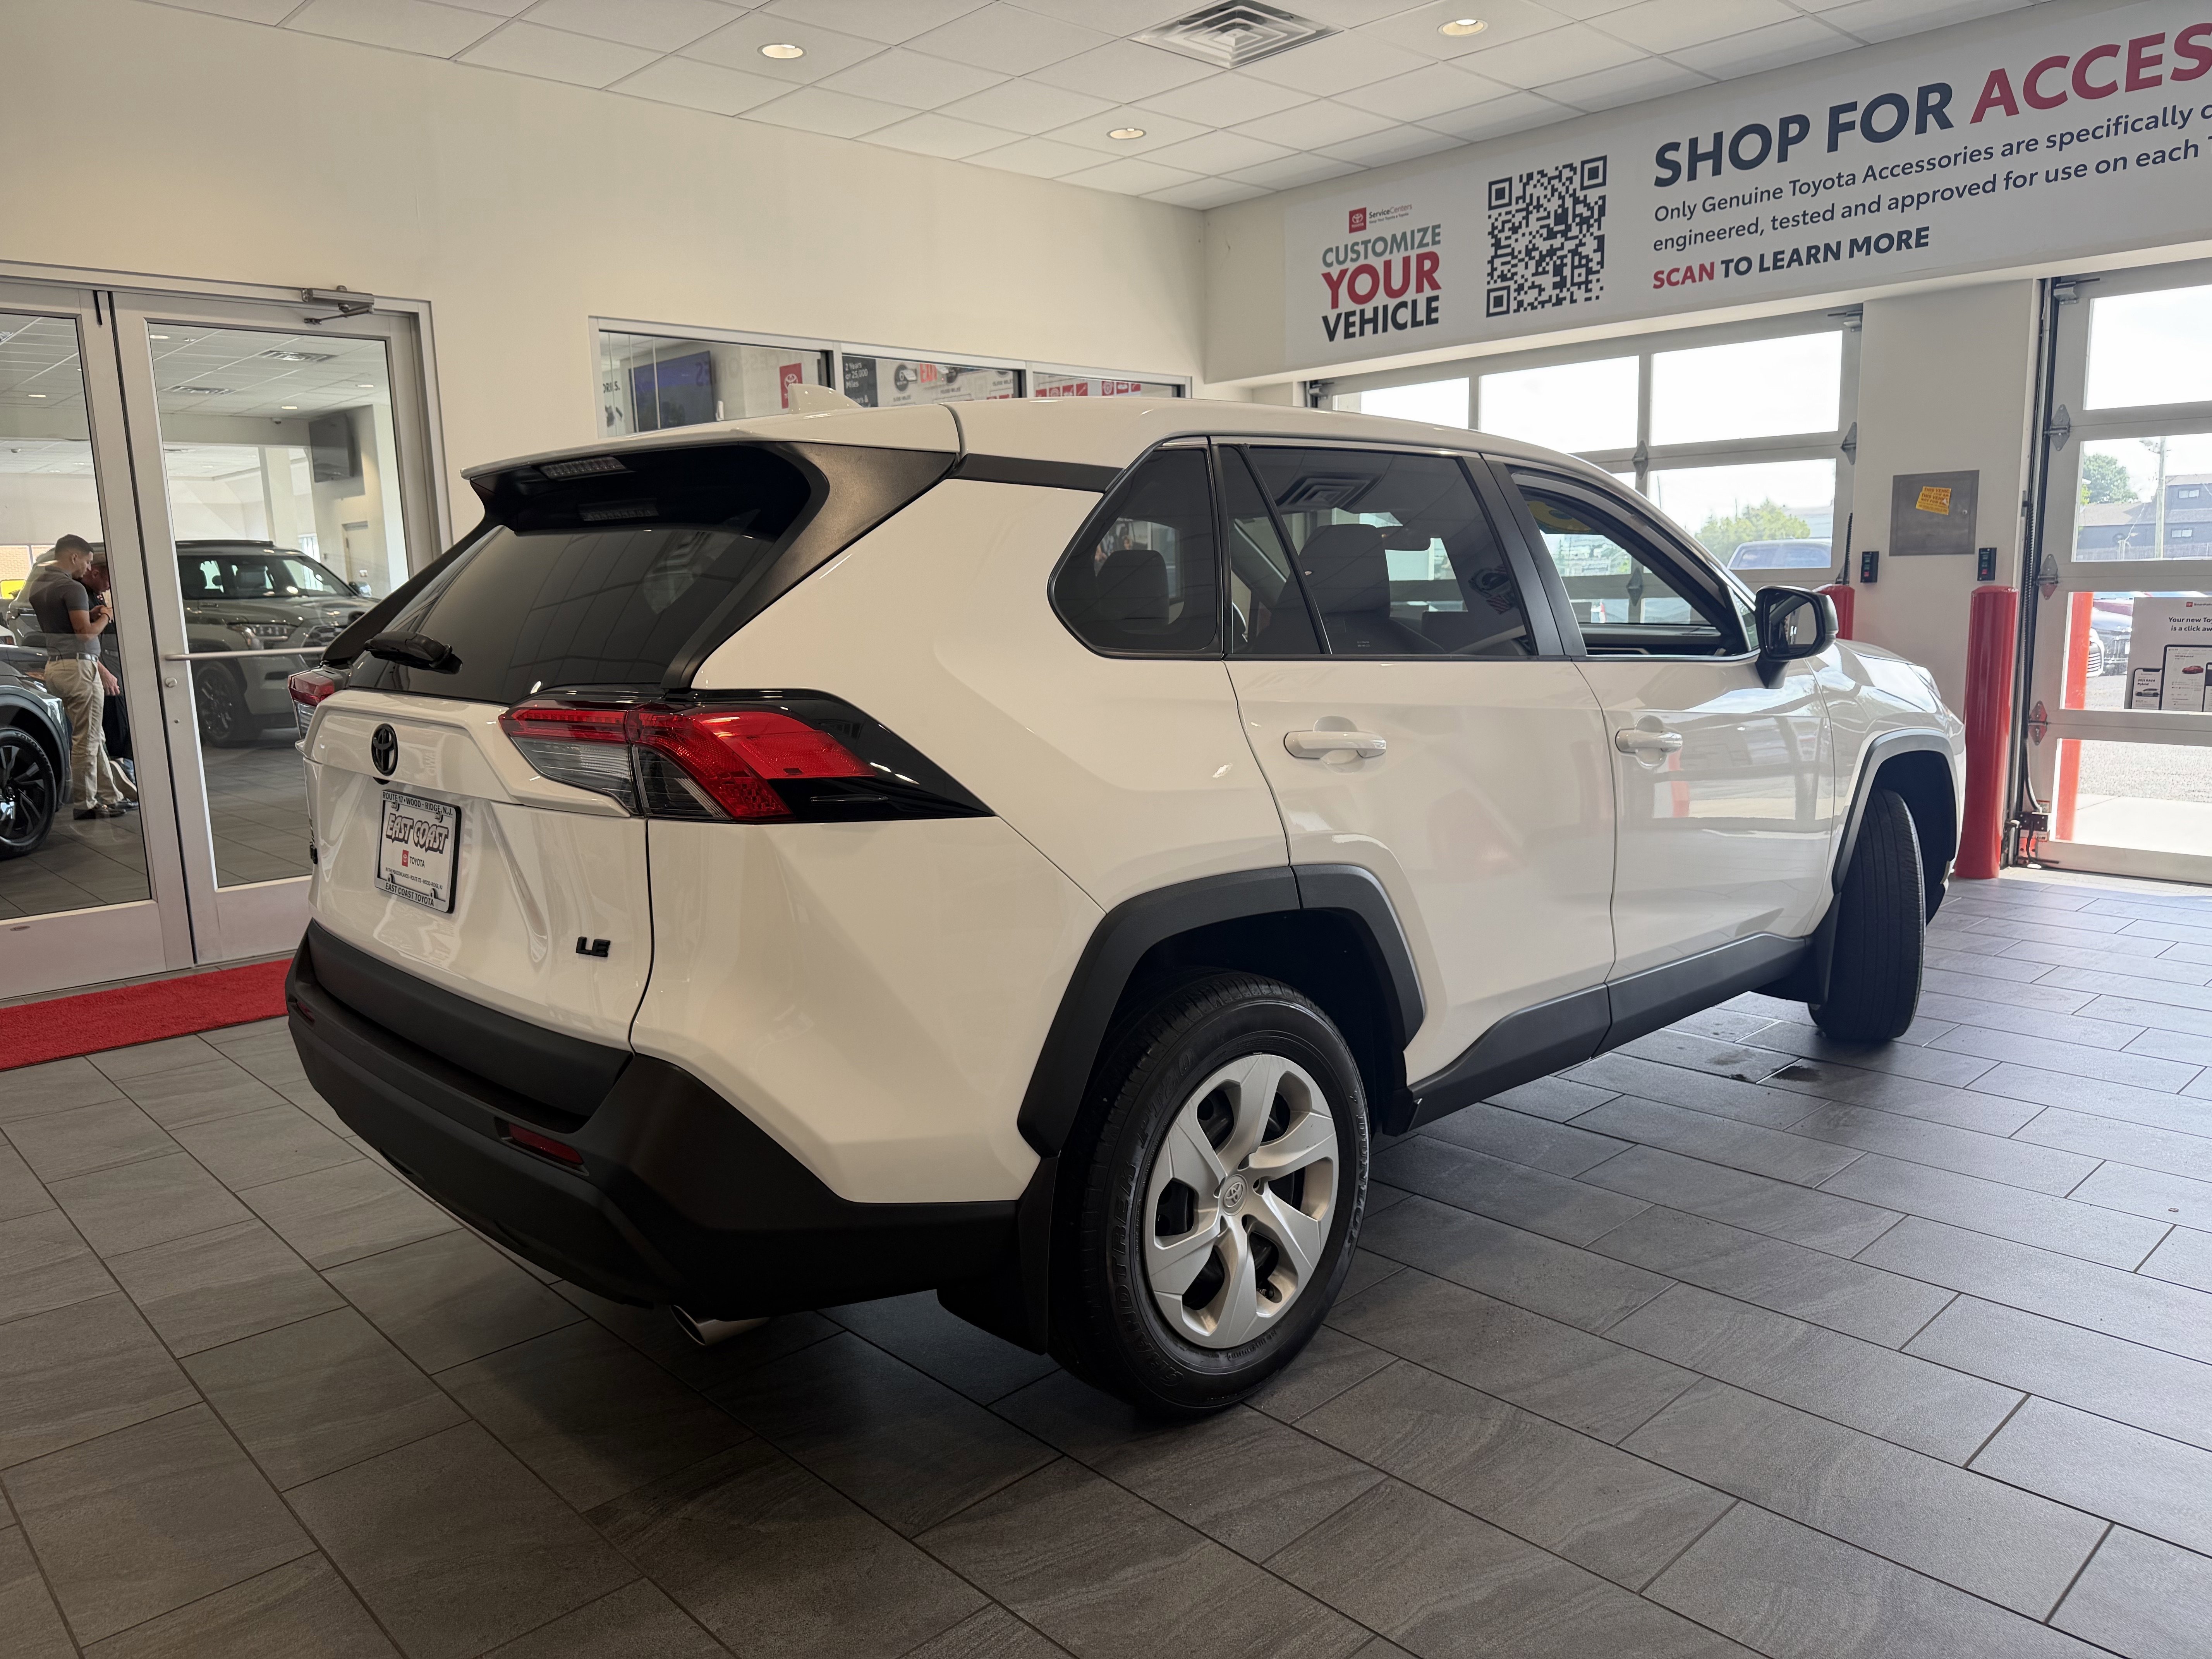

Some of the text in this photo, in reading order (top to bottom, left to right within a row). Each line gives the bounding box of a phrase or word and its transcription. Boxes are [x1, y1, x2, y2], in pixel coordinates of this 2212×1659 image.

[1654, 22, 2212, 187] SHOP FOR ACCES
[1655, 200, 1697, 222] Only
[1702, 185, 1783, 213] Genuine
[1789, 171, 1856, 198] Toyota
[1862, 146, 1994, 184] Accessories
[2001, 138, 2039, 157] are
[2045, 105, 2194, 152] specifically
[1653, 138, 2199, 252] engineered, tested and approved for use on each
[1322, 223, 1441, 268] CUSTOMIZE
[1653, 226, 1930, 289] SCAN TO LEARN MORE
[1321, 251, 1442, 309] YOUR
[1321, 294, 1439, 342] VEHICLE
[382, 791, 398, 802] ROUTE
[405, 797, 421, 807] WOOD
[385, 812, 449, 854] EAST COAST
[409, 856, 425, 868] TOYOTA
[385, 882, 434, 907] EAST COAST TOYOTA
[575, 936, 611, 958] LE
[1347, 1114, 1368, 1259] DUNLOP
[1109, 1161, 1184, 1387] GRANDTREK
